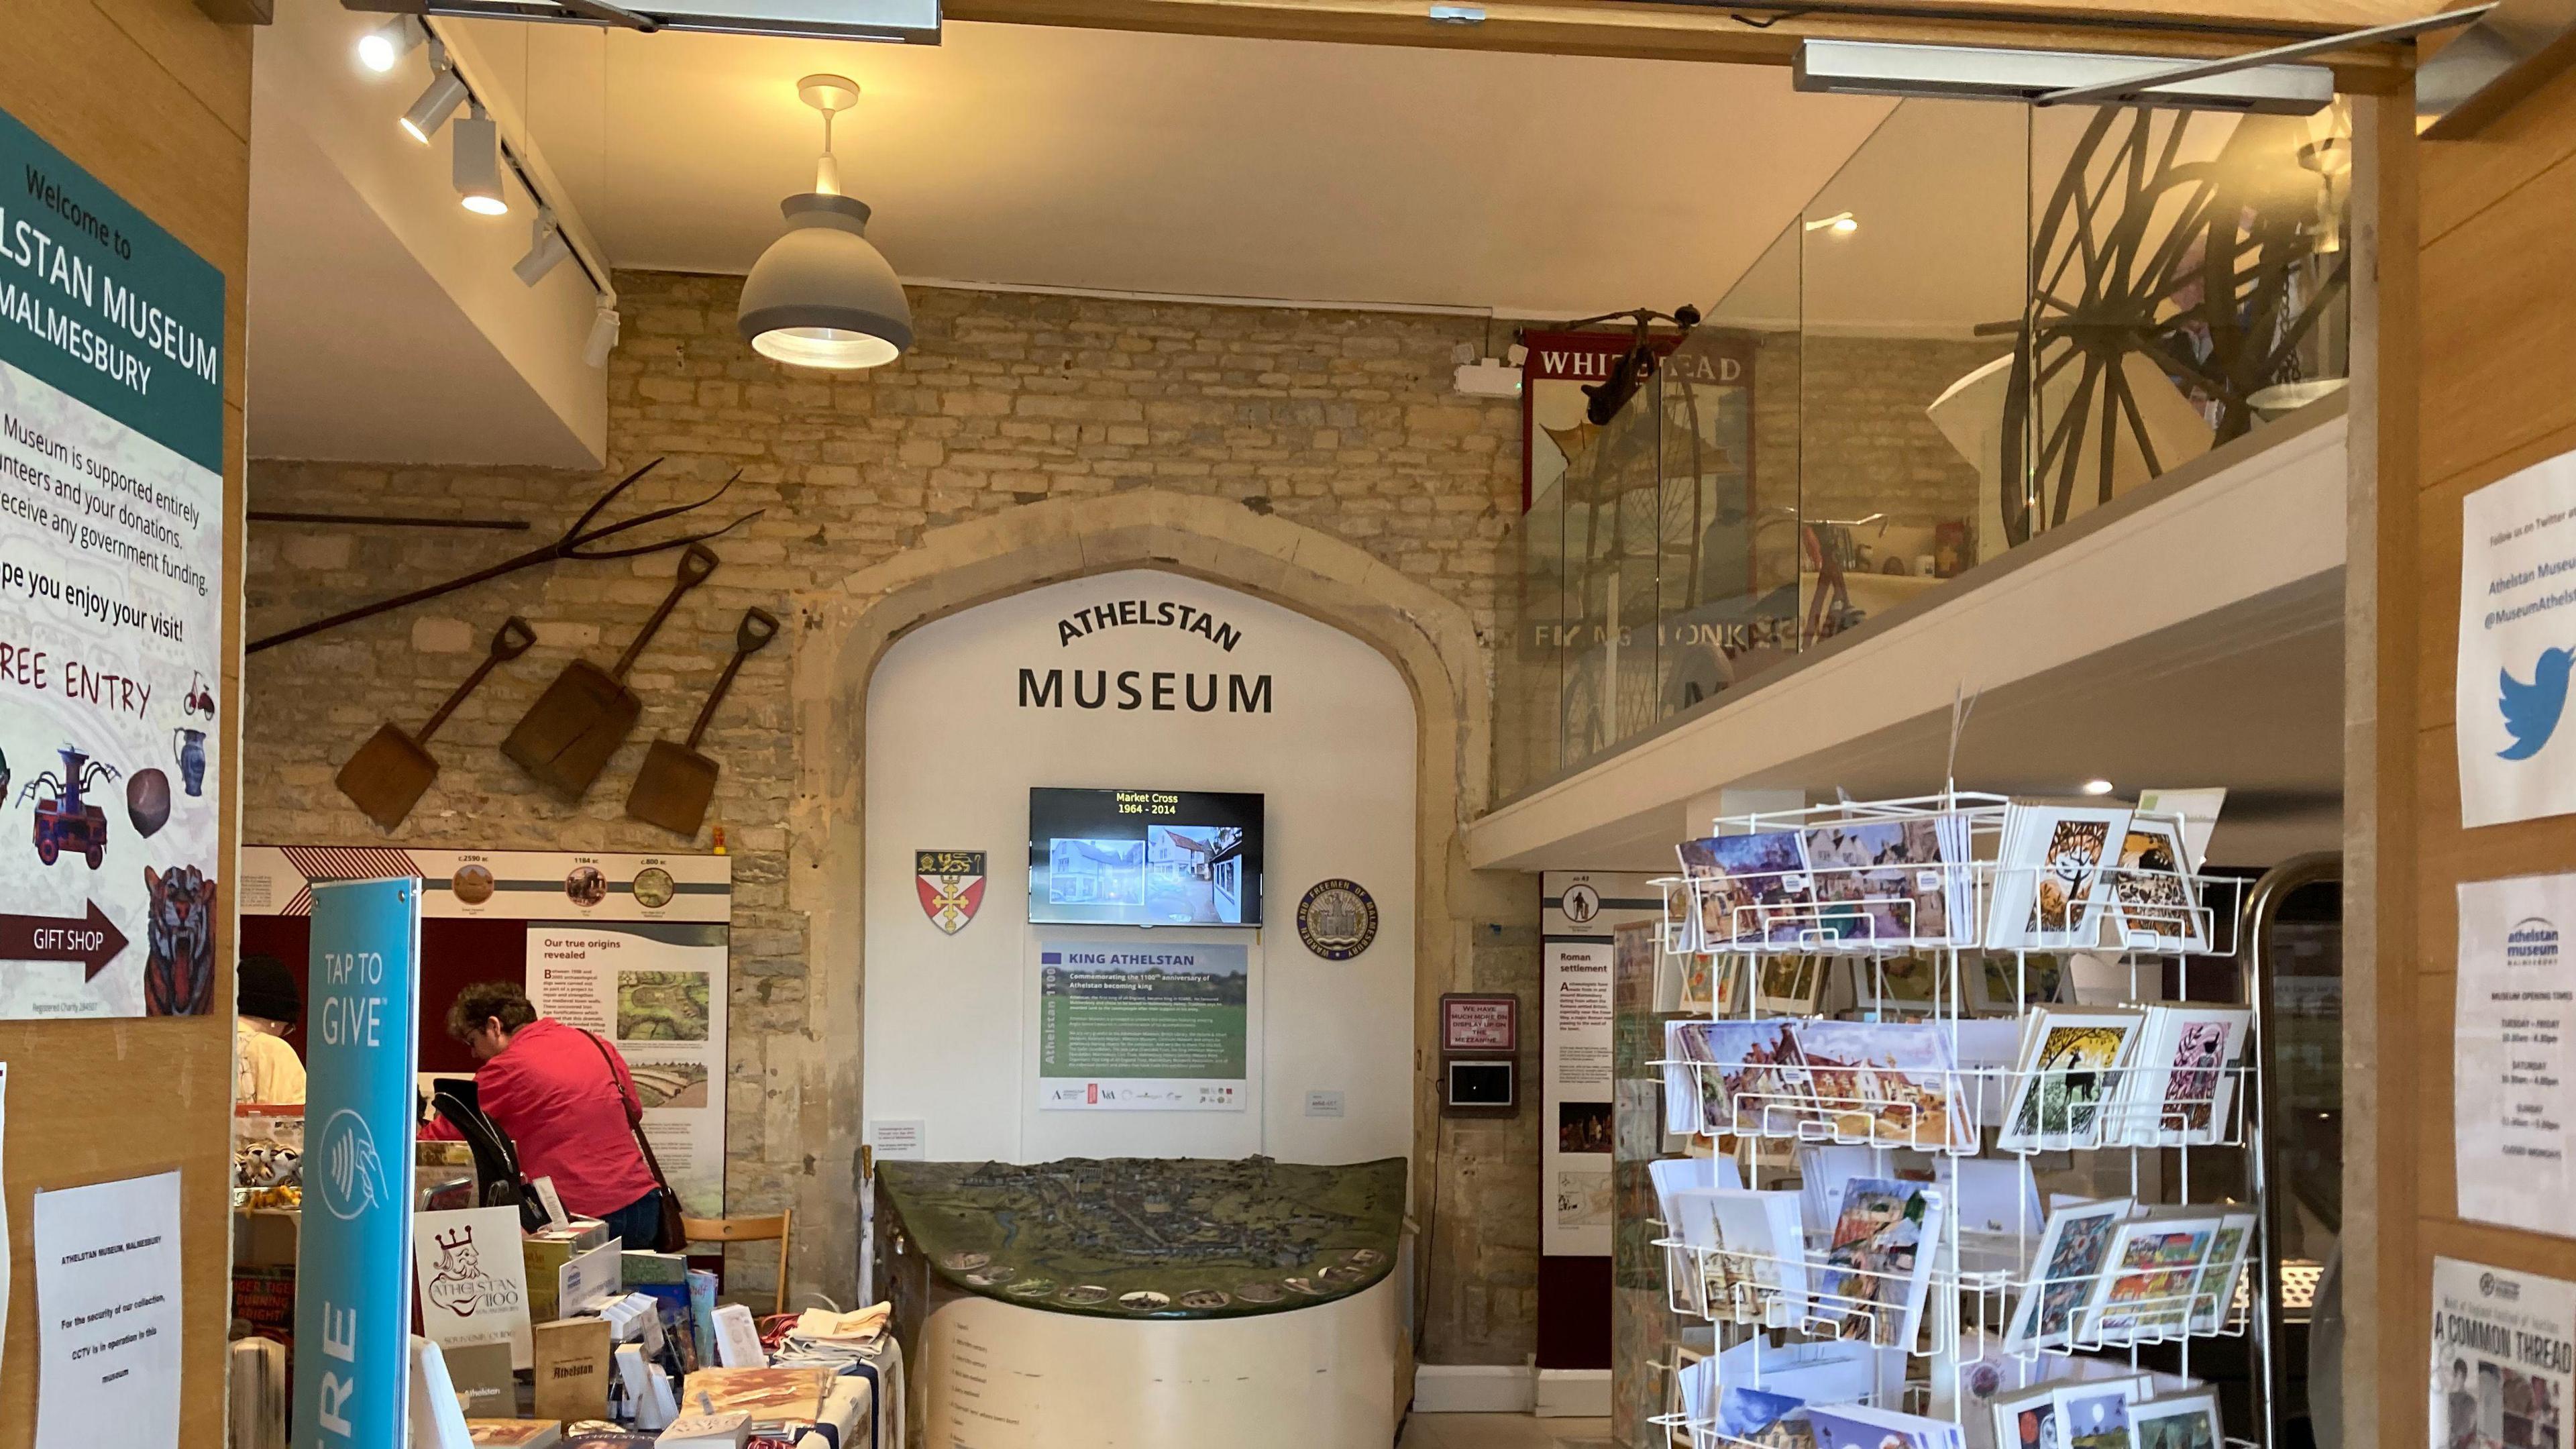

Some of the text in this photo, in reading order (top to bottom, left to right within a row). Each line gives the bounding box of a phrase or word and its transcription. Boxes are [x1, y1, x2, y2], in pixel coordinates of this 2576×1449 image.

[26, 164, 131, 260] Welcome to
[0, 277, 151, 396] MALMESBURY
[104, 276, 217, 385] MUSEUM
[5, 413, 199, 530] Museum is supported entirely
[55, 479, 81, 505] and
[85, 490, 115, 521] your
[119, 506, 182, 549] donations.
[2524, 523, 2534, 534] on
[2536, 513, 2565, 529] Twitter
[52, 513, 78, 544] any
[81, 525, 159, 573] government
[162, 555, 209, 596] funding.
[2489, 570, 2534, 595] Athelstan
[29, 570, 60, 600] you
[66, 586, 109, 622] enjoy
[113, 602, 148, 629] your
[151, 613, 183, 643] visit!
[1058, 600, 1242, 653] ATHELSTAN
[66, 661, 151, 720] ENTRY
[1019, 668, 1271, 713] MUSEUM
[1116, 793, 1178, 803] Market Cross
[1119, 804, 1143, 813] 1964
[1152, 805, 1175, 814] 2014
[1309, 881, 1350, 898] FREEMEN
[1355, 888, 1365, 897] OF
[34, 928, 103, 952] GIFT SHOP
[544, 939, 562, 947] Our
[588, 940, 621, 950] origins
[2508, 928, 2559, 943] athelstan
[544, 951, 585, 959] revealed
[1069, 954, 1194, 965] KING ATHELSTAN
[2508, 945, 2559, 957] museum
[325, 953, 382, 984] TAP TO
[1070, 973, 1126, 982] Commemorating
[1560, 964, 1607, 972] settlement
[1104, 983, 1136, 991] becoming
[1138, 983, 1152, 991] king
[1045, 968, 1056, 1065] Athelstan 1100
[62, 1250, 97, 1265] ATHELSTAN
[434, 1278, 517, 1296] ATHELSTAN
[62, 1320, 72, 1330] For
[74, 1314, 85, 1326] the
[87, 1308, 113, 1322] security
[115, 1305, 121, 1314] of
[123, 1303, 133, 1312] our
[72, 1347, 91, 1360] CCTV
[108, 1334, 138, 1350] operation
[2435, 1311, 2445, 1340] A
[2449, 1313, 2512, 1359] COMMON
[2517, 1331, 2572, 1375] THREAD
[553, 1364, 593, 1379] Athelstan
